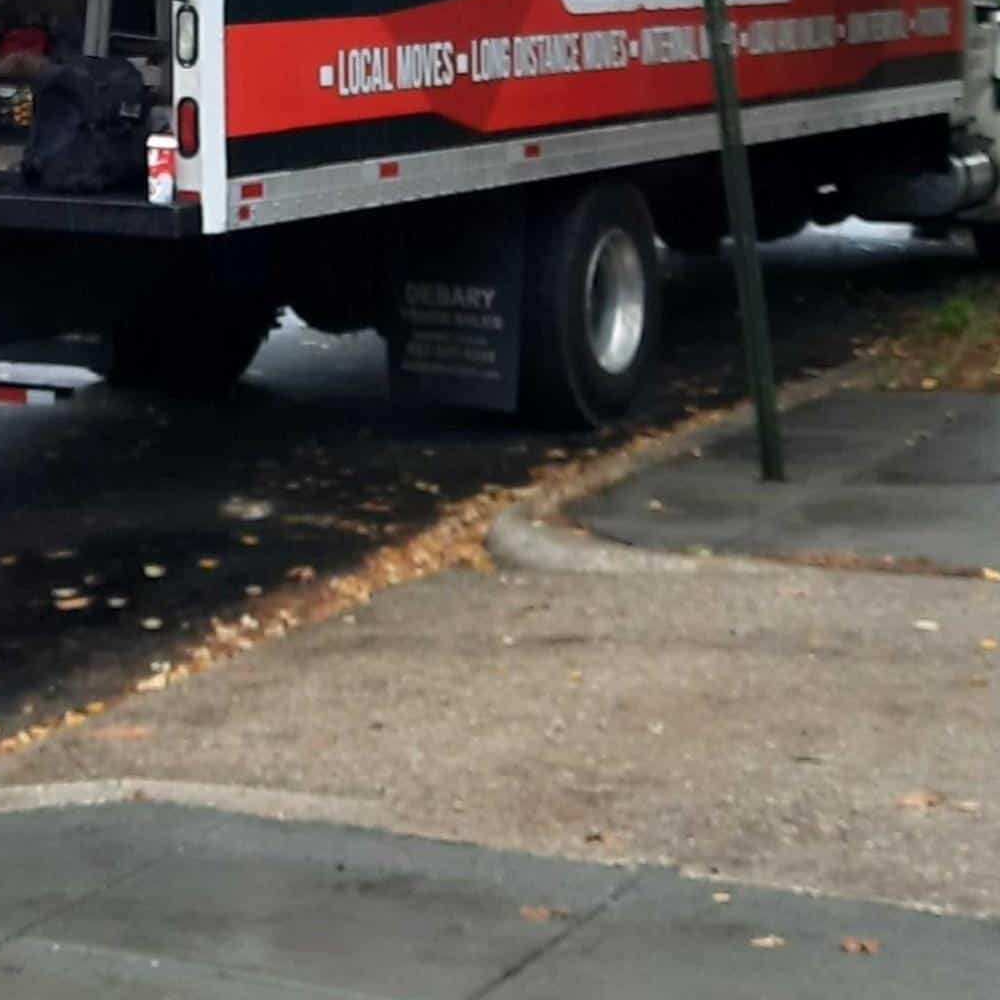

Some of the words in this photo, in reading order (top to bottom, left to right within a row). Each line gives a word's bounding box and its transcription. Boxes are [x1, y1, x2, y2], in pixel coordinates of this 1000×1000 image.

[338, 47, 393, 96] LOCAL
[396, 42, 455, 89] MOVES
[471, 38, 511, 82] LONG
[513, 33, 580, 77] DISTANCE
[582, 29, 628, 70] MOVES
